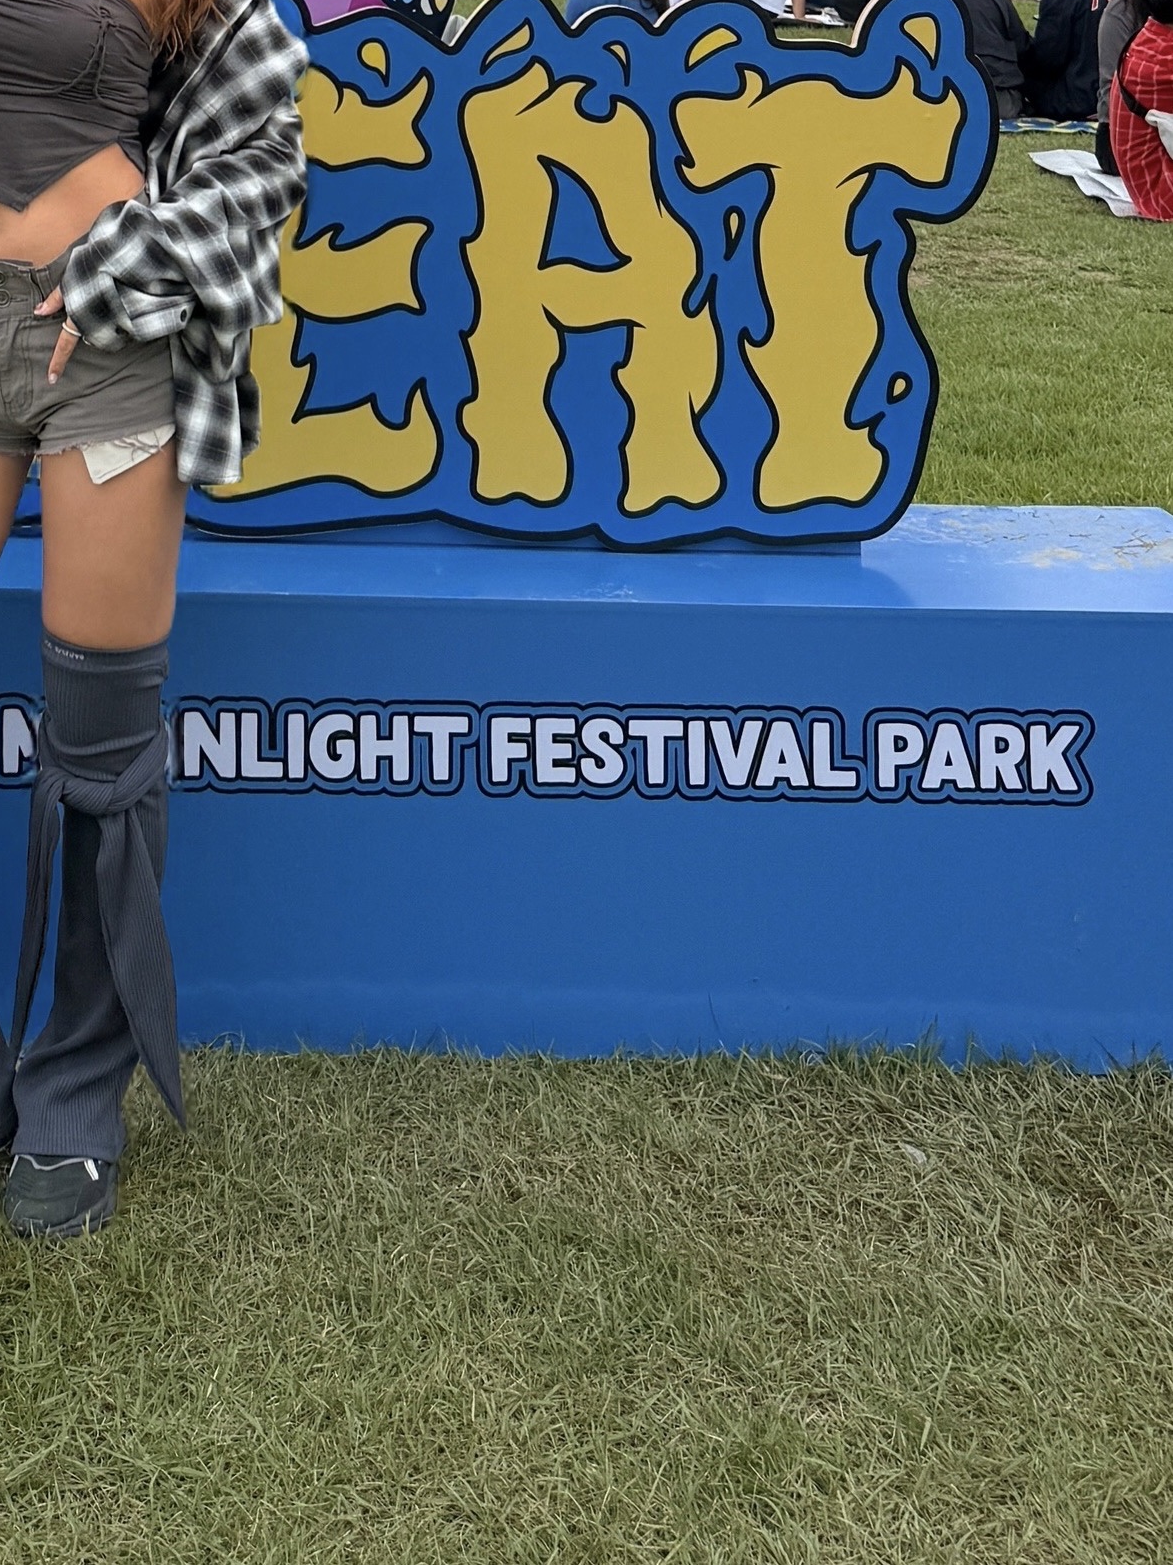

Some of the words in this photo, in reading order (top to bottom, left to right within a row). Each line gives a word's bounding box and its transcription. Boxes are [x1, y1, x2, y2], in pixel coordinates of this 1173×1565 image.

[3, 708, 469, 783] MNLIGHT
[491, 717, 857, 788] FESTIVAL
[878, 723, 1081, 791] PARK
